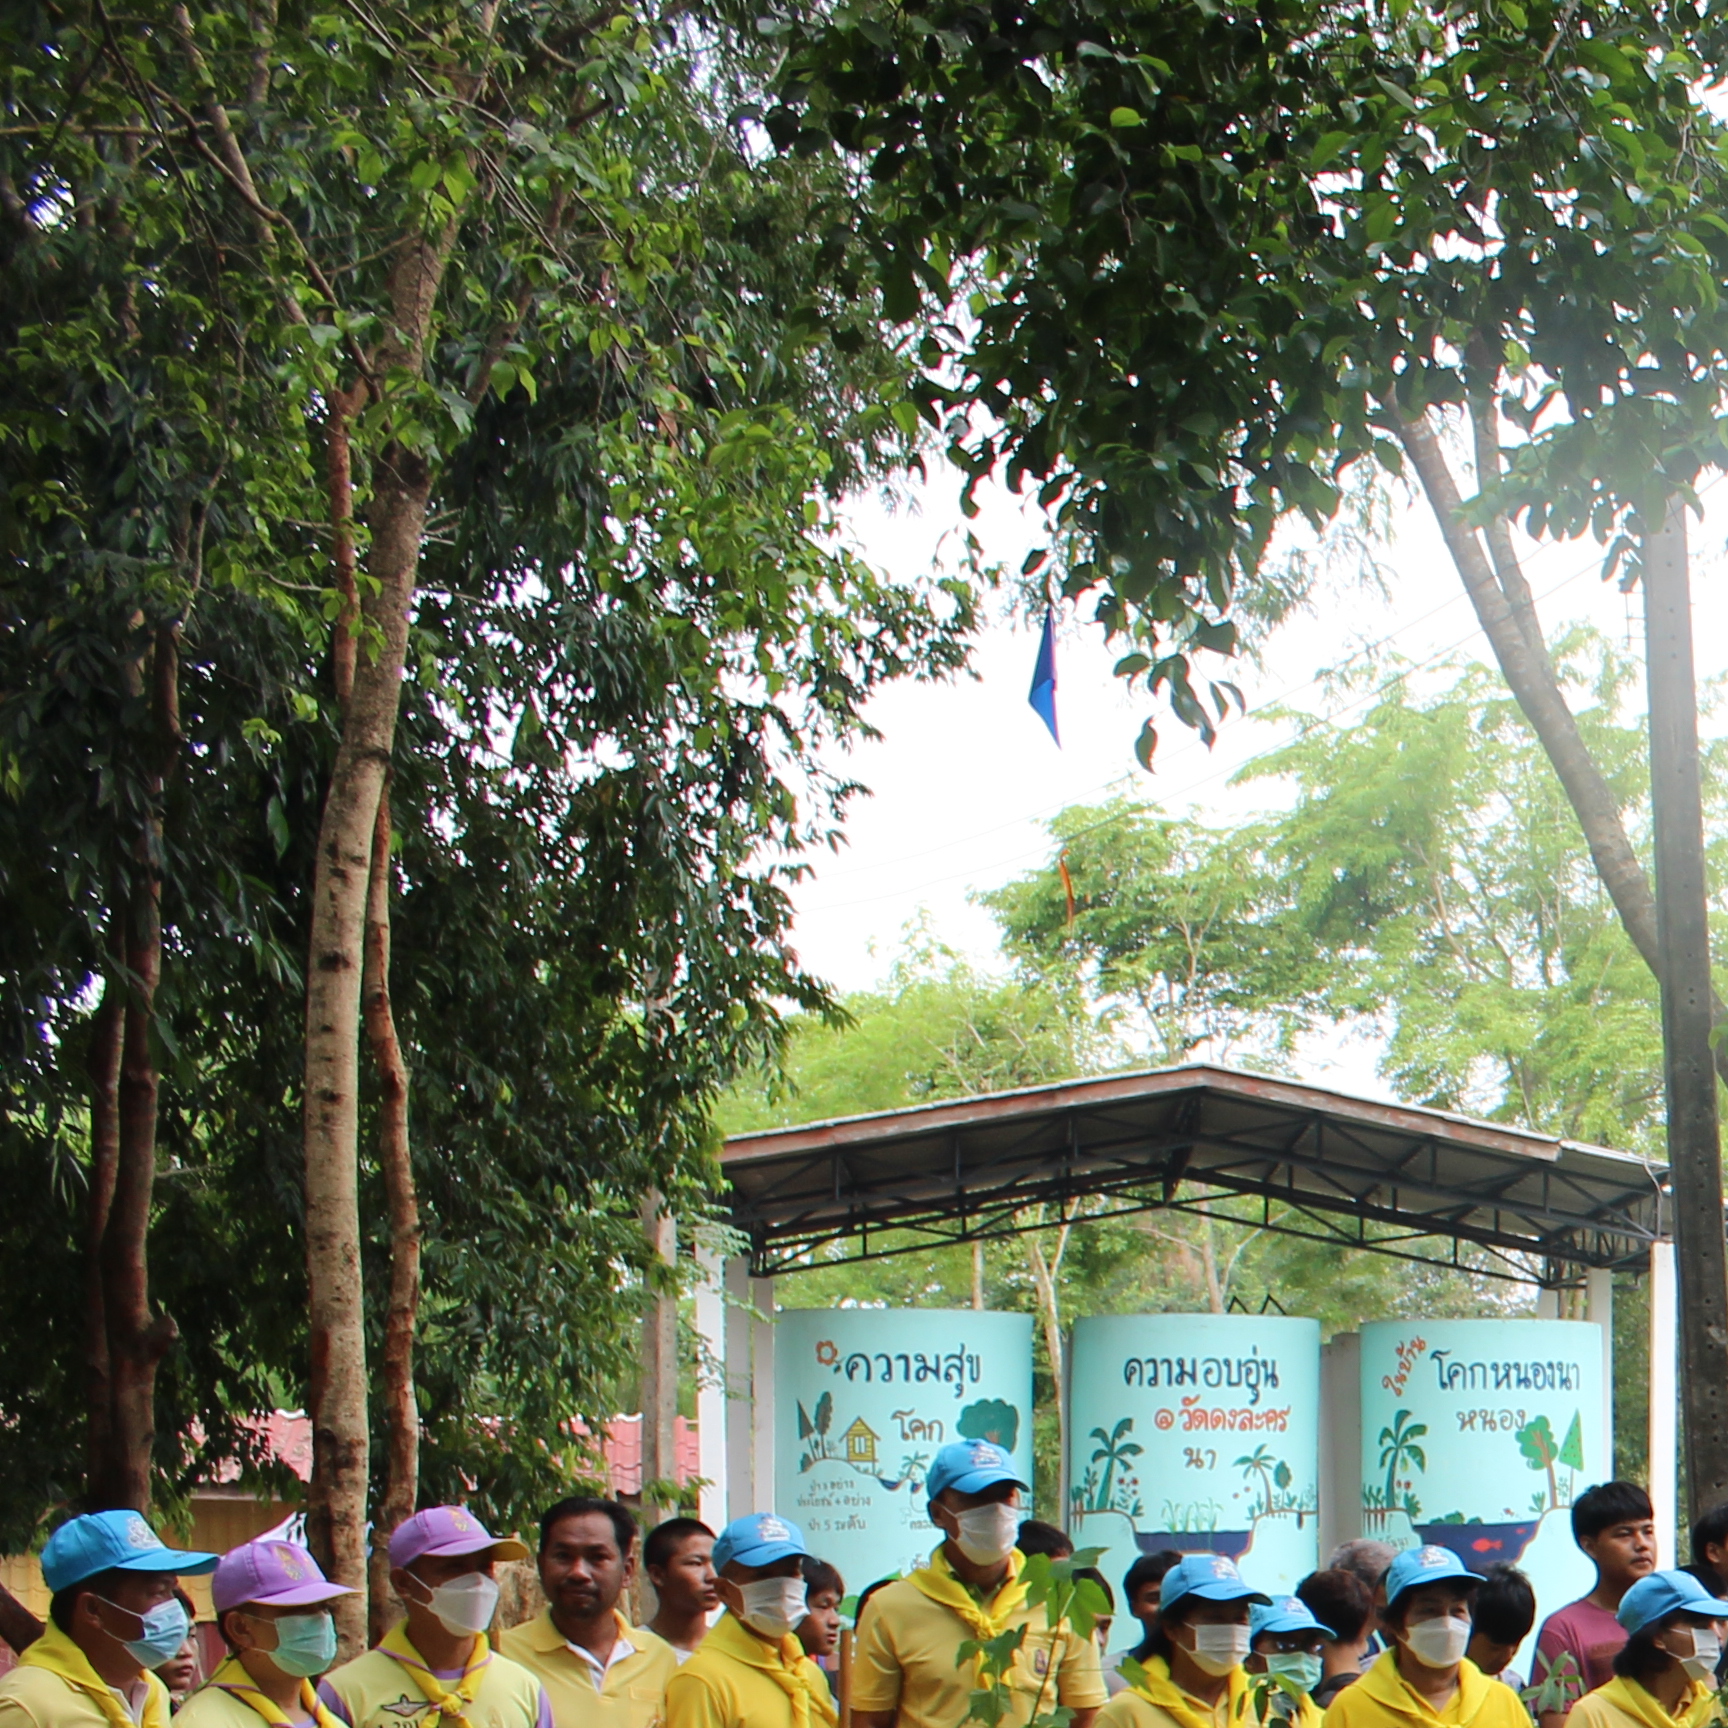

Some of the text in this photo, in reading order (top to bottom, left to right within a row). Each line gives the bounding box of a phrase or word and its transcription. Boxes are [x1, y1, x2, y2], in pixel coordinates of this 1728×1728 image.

[845, 1343, 981, 1398] ความสุข
[891, 1408, 943, 1442] โคก
[1178, 1394, 1291, 1432] วัดดงละคร
[1456, 1408, 1526, 1432] หนอง
[1183, 1446, 1217, 1470] นา
